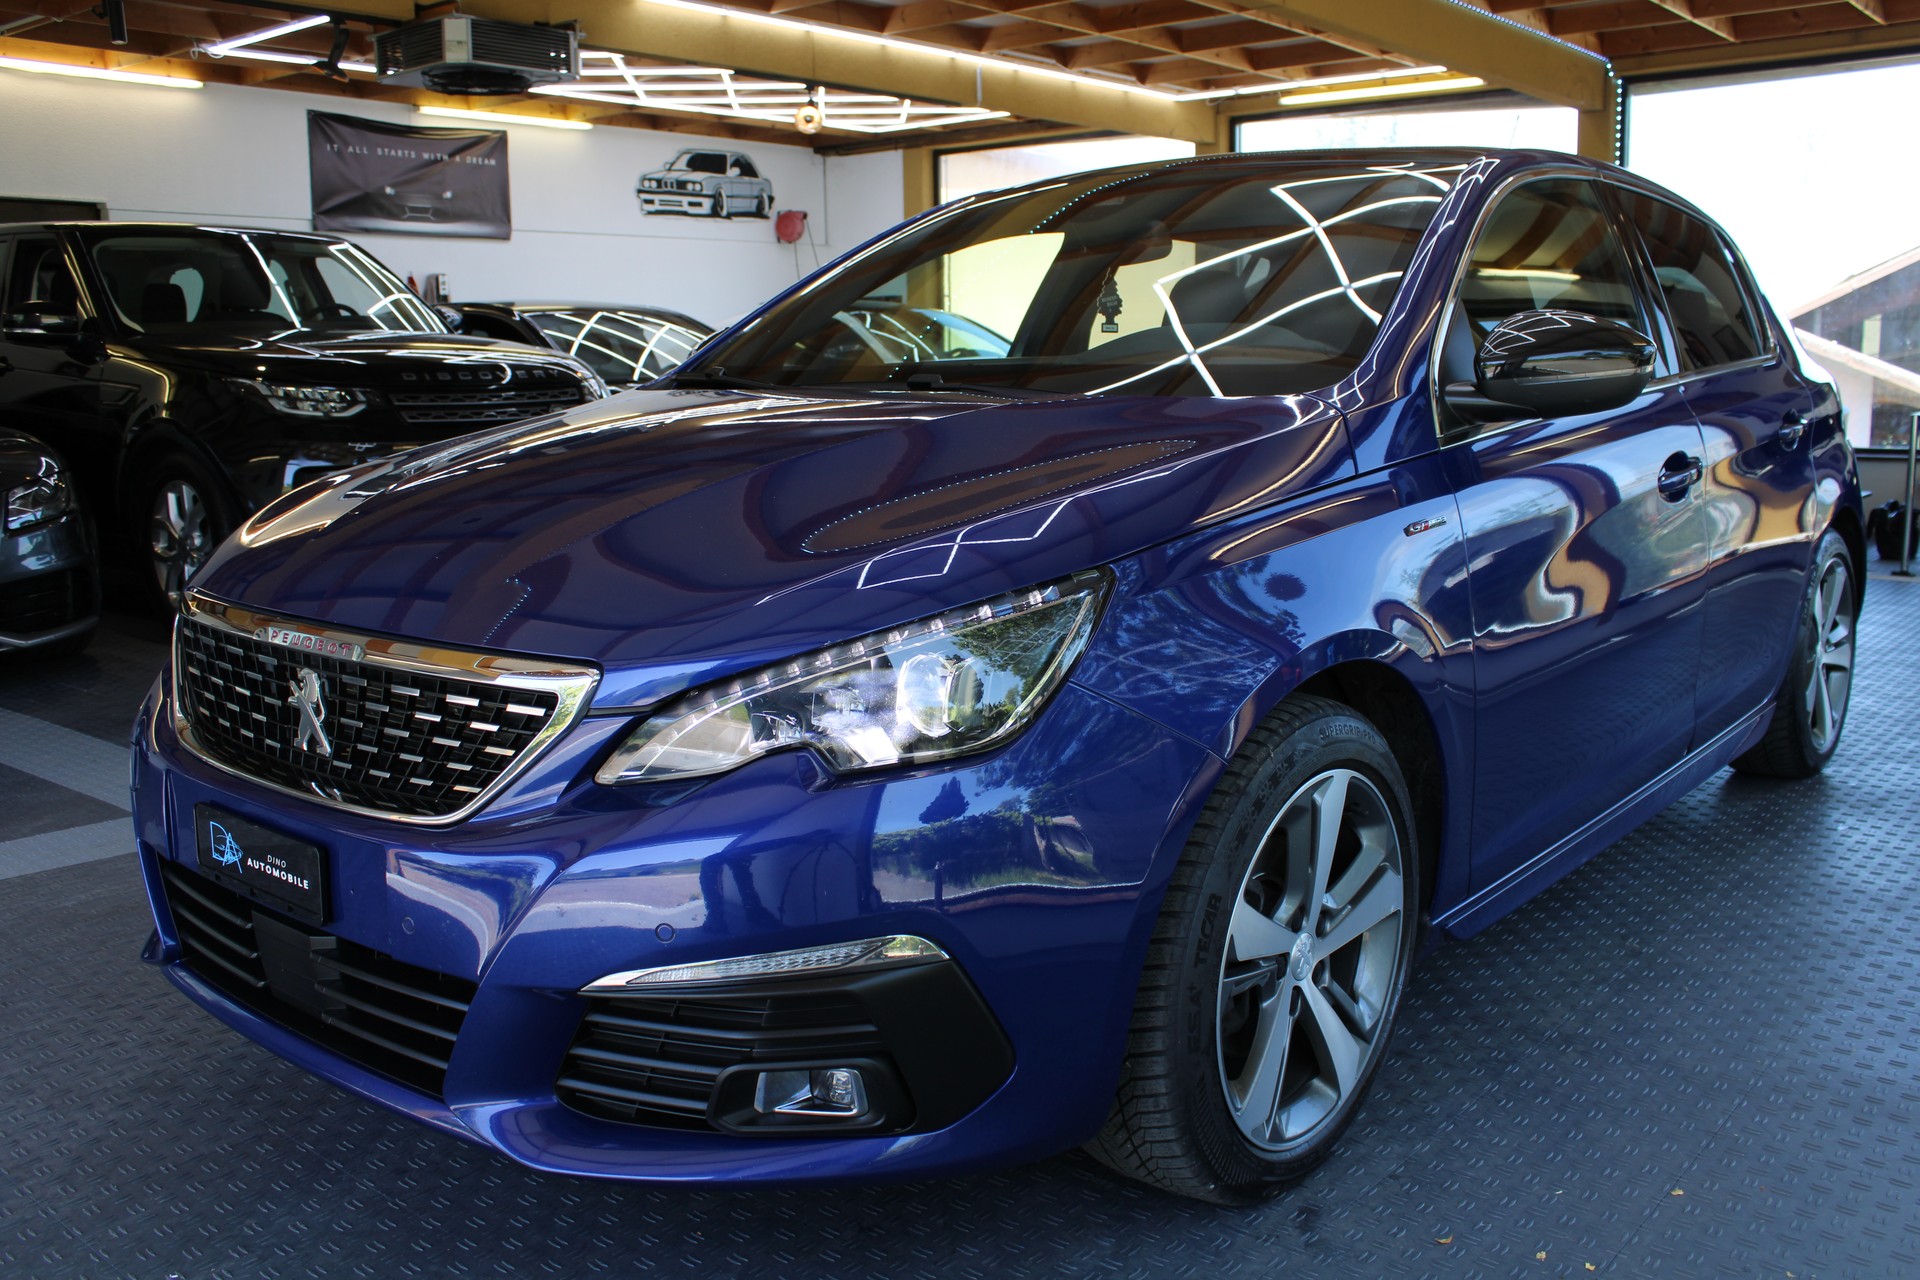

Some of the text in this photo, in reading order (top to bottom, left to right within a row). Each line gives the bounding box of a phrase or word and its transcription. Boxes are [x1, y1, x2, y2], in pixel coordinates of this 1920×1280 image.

[326, 143, 339, 153] IT
[347, 145, 369, 155] ALL
[377, 147, 417, 159] STARTS
[422, 153, 449, 162] WITH
[466, 157, 497, 166] DREAM
[401, 369, 560, 381] DISCOVERY
[271, 629, 352, 656] PEUGEOT
[1319, 723, 1378, 745] SUPERGRIP PRO
[267, 854, 287, 868] DINO
[247, 857, 309, 889] AUTOMOBILE
[1194, 893, 1222, 968] TECAR
